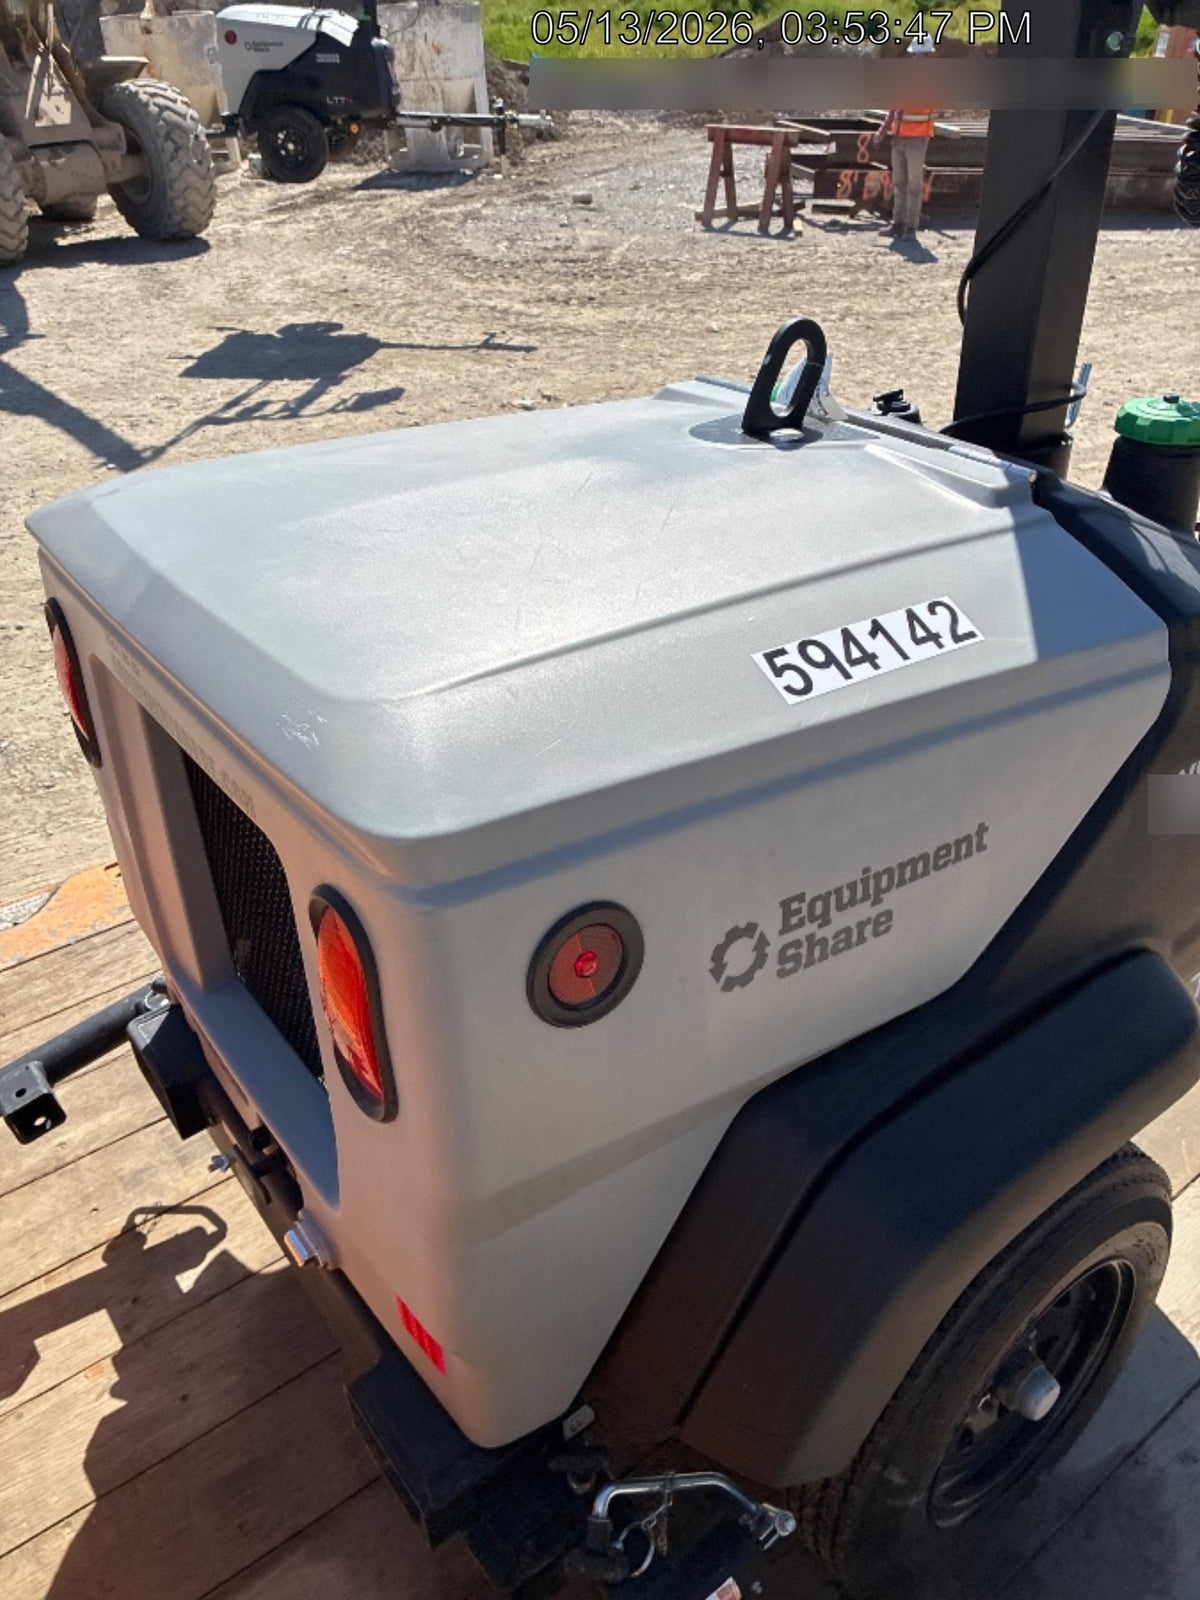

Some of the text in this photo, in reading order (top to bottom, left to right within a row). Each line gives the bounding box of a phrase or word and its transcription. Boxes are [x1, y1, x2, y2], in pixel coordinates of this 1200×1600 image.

[762, 600, 978, 696] 594142
[778, 822, 989, 936] Equipment
[776, 908, 893, 979] Share
